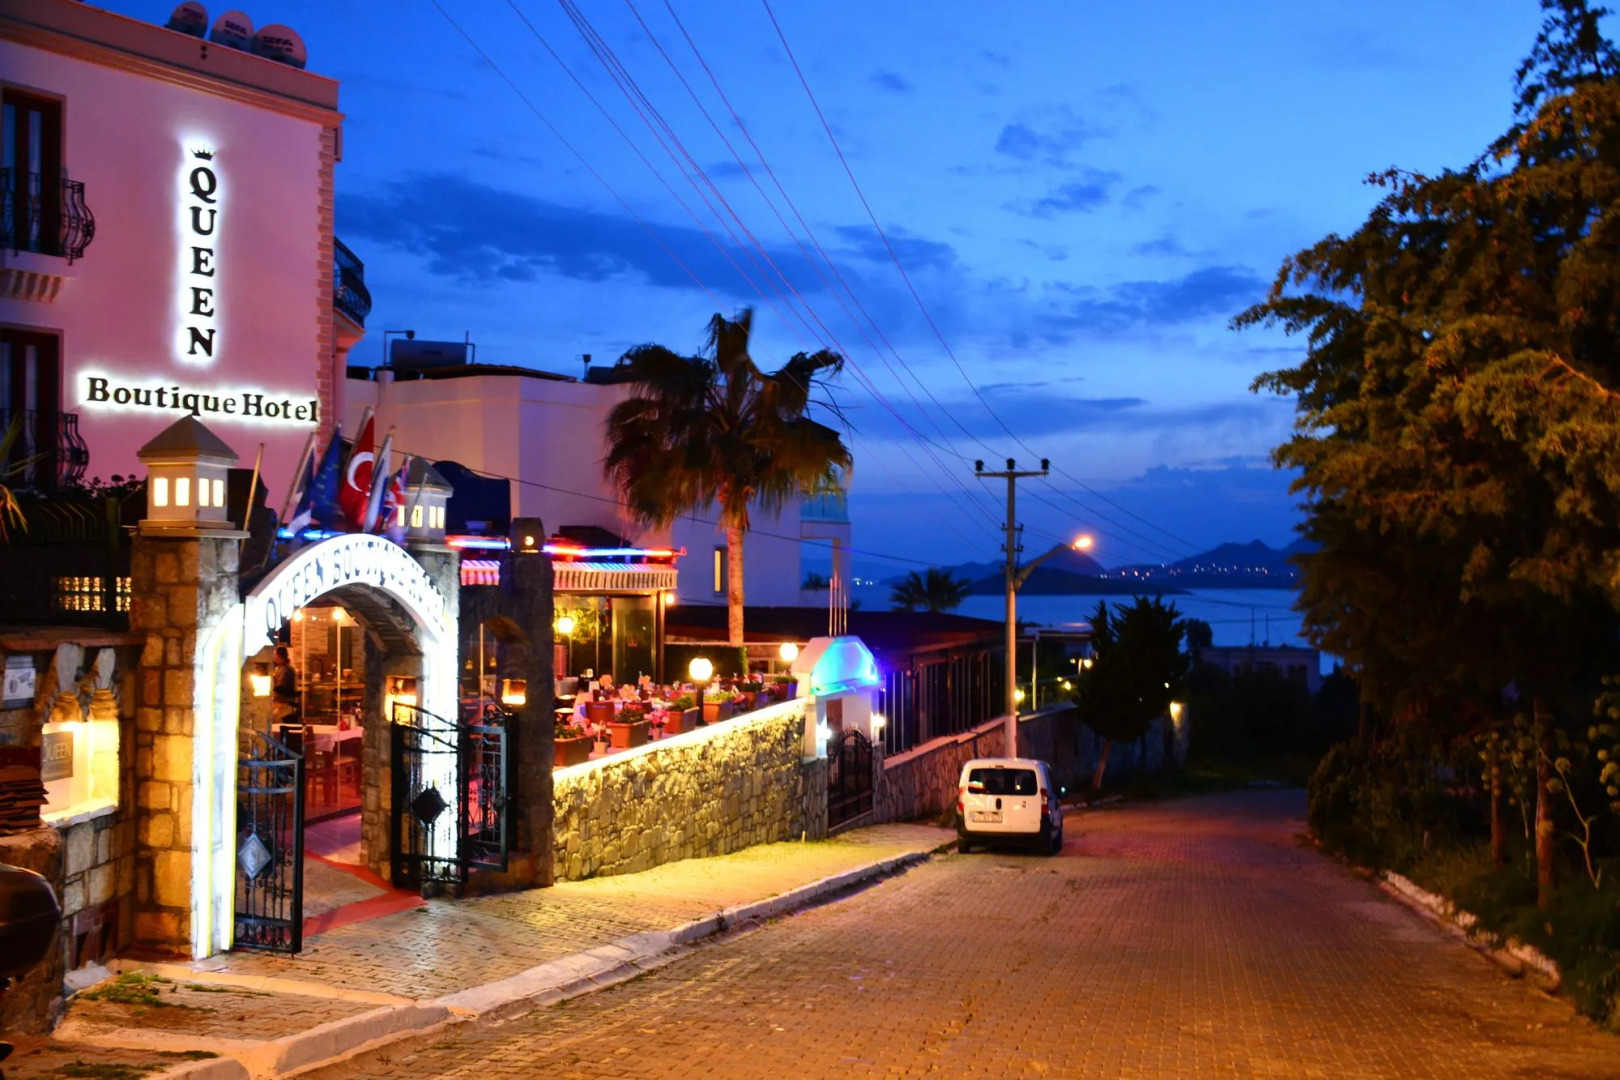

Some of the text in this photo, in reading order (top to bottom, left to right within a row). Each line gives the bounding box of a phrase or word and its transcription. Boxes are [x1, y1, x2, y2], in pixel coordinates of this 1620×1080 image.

[187, 166, 217, 358] QUEEN
[86, 376, 318, 423] Boutique Hotel
[266, 551, 327, 644] QUEEN
